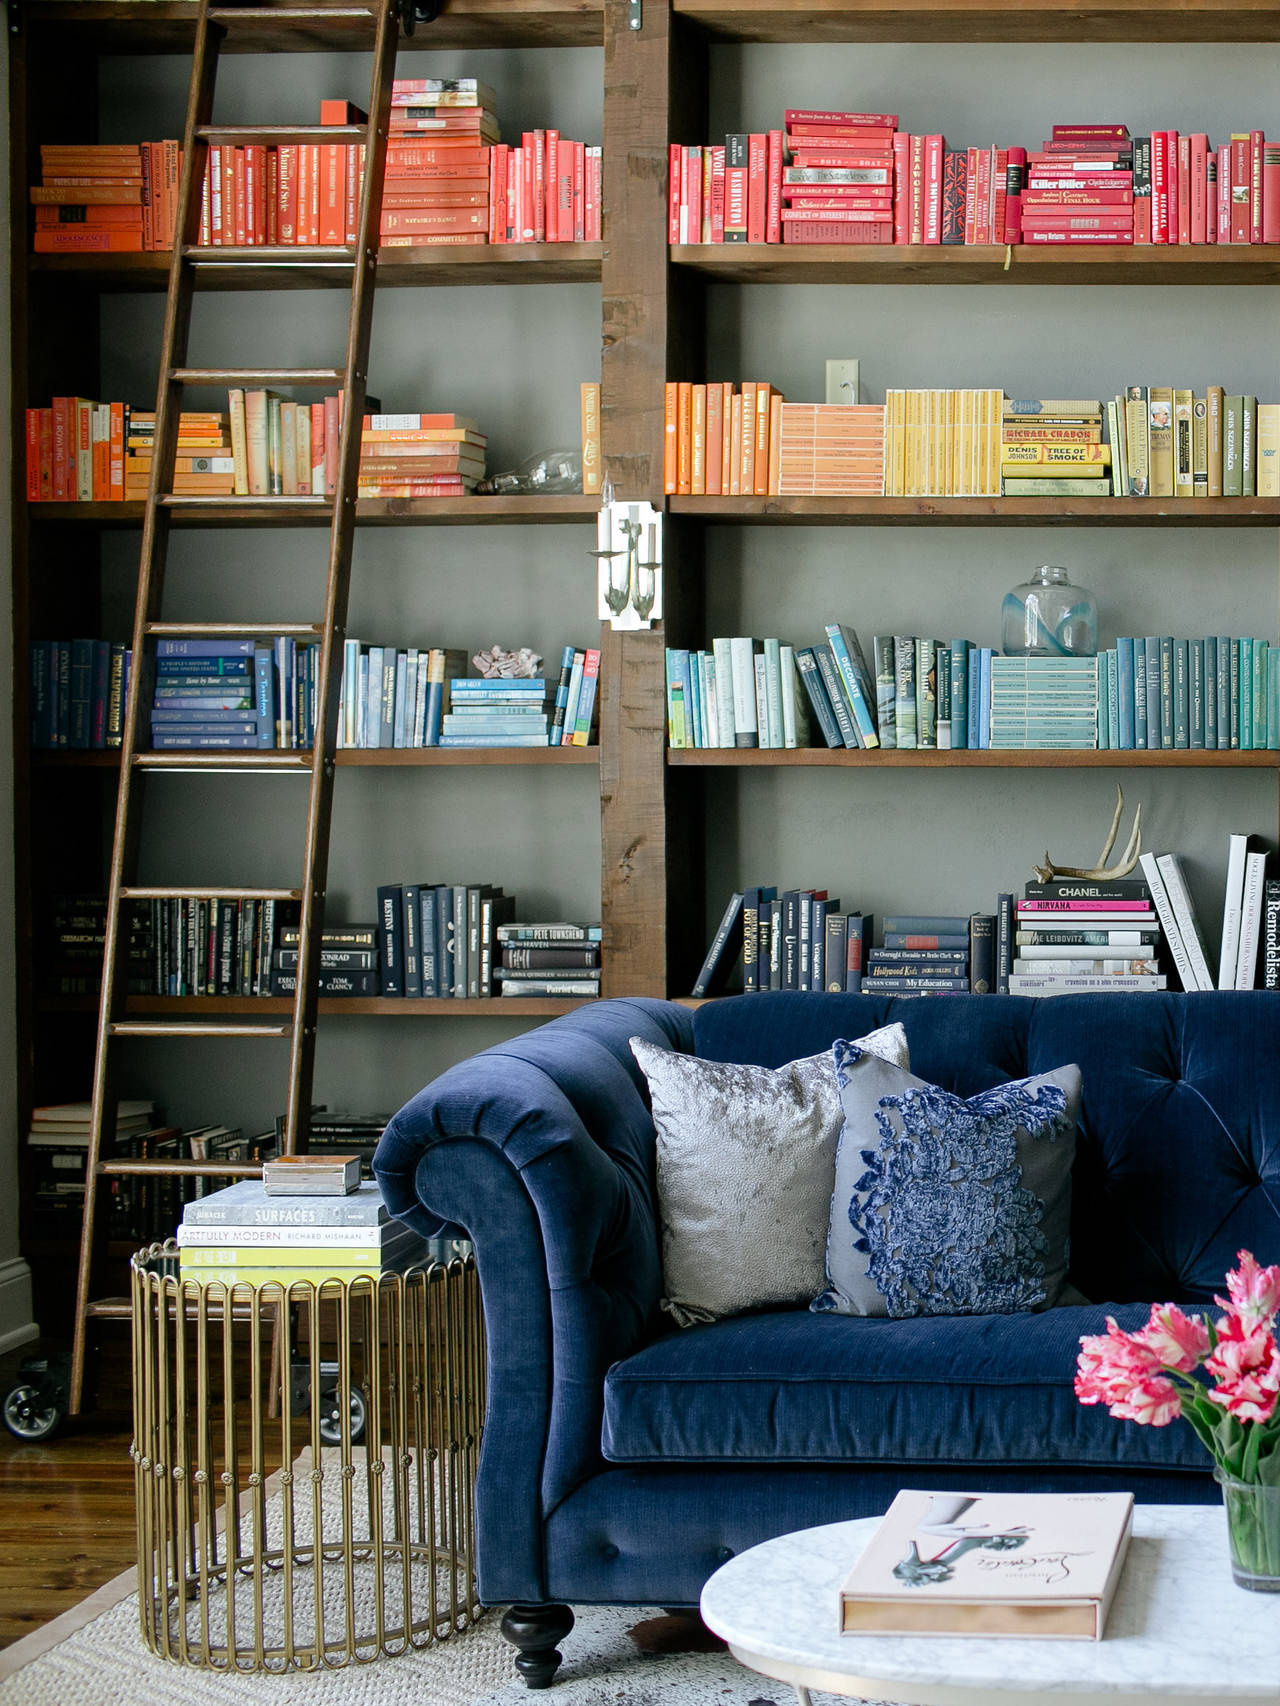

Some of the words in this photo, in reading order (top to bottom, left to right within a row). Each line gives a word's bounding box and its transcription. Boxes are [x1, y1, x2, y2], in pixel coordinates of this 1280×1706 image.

[280, 148, 290, 179] Manual
[713, 150, 725, 176] Wolf
[1169, 140, 1177, 168] ASCENT
[281, 180, 290, 189] of
[713, 179, 724, 200] Hall
[967, 175, 975, 191] THE
[279, 191, 290, 213] Style
[730, 171, 743, 224] WASHINGTON
[967, 193, 975, 224] JUNGLE
[928, 182, 938, 239] BLOODLINE
[56, 425, 64, 461] ROWLING
[1006, 430, 1048, 438] MICHAEL
[1050, 430, 1091, 438] CHABON
[60, 650, 69, 683] COACH
[841, 656, 861, 699] DECORATE
[1058, 888, 1101, 897] CHANEL
[384, 898, 393, 931] DESTINY
[744, 908, 752, 924] POT
[1037, 901, 1071, 910] NIRVANA
[534, 930, 548, 939] PETE
[549, 930, 585, 939] TOWNSHEND
[744, 926, 752, 937] OF
[1046, 935, 1083, 943] LEIBOVITZ
[1159, 907, 1180, 954] GREATEST
[1174, 952, 1187, 974] HITS
[744, 939, 752, 965] GOLD
[1265, 900, 1280, 988] Remodelista
[813, 942, 822, 980] Vengeance
[873, 965, 904, 976] Hollywood
[905, 965, 918, 975] Kids
[905, 978, 916, 988] My
[918, 978, 953, 987] Education
[255, 1209, 315, 1222] SURFACES
[182, 1231, 230, 1240] ARTFULLY
[235, 1231, 281, 1240] MODERN
